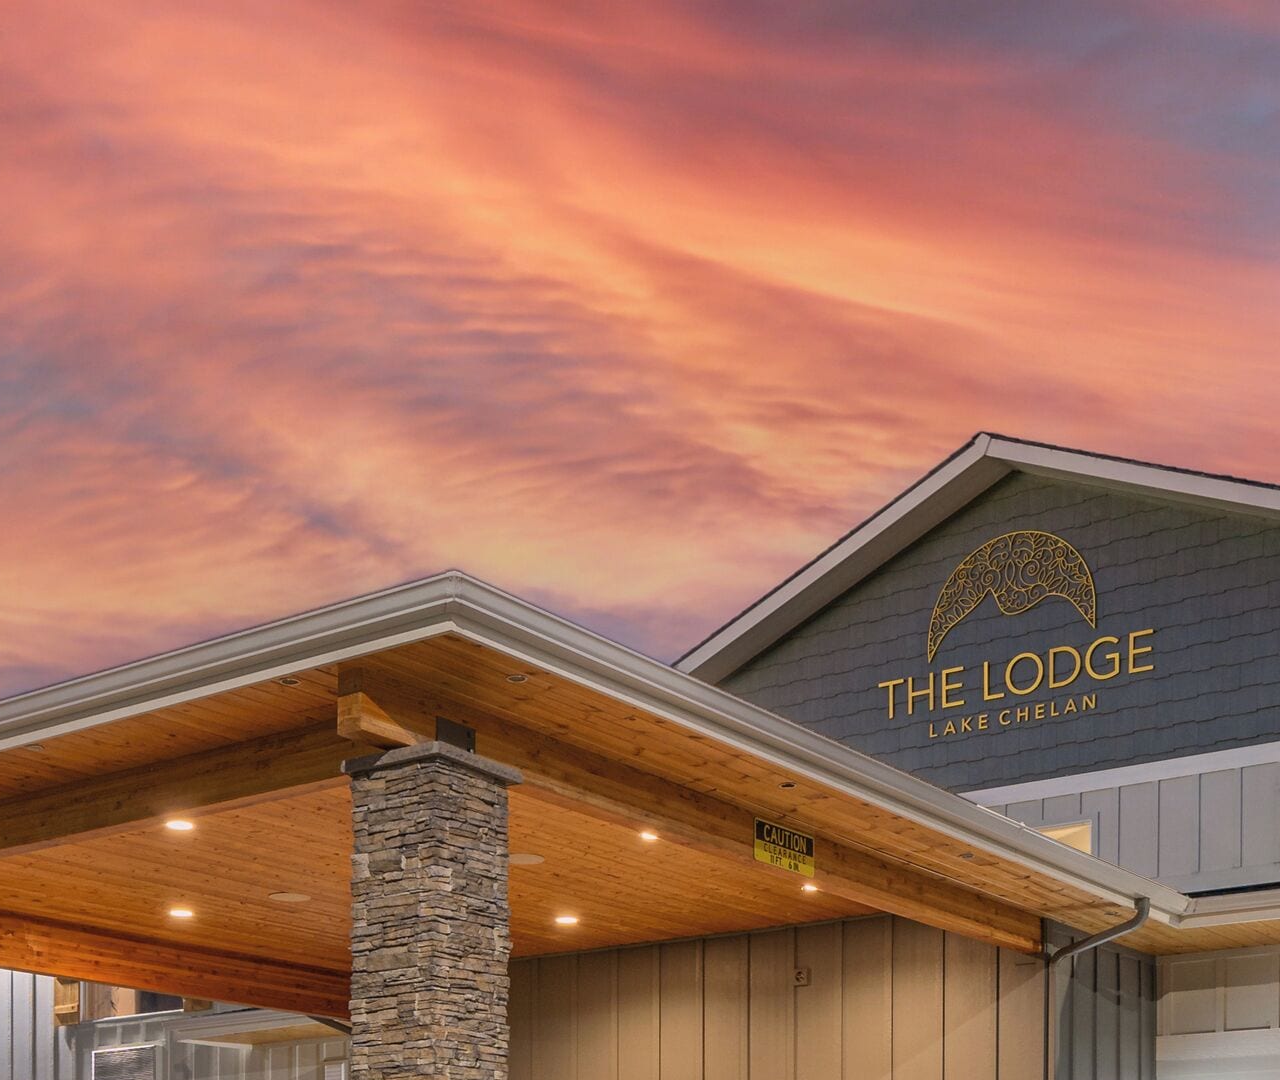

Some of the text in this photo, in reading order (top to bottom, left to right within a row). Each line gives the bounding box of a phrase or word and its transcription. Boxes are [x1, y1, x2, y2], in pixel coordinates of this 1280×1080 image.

[878, 628, 1155, 719] THE LODGE
[928, 694, 1097, 738] LAKE CHELAN
[763, 843, 806, 864] CLEARANCE
[764, 825, 806, 853] CAUTION
